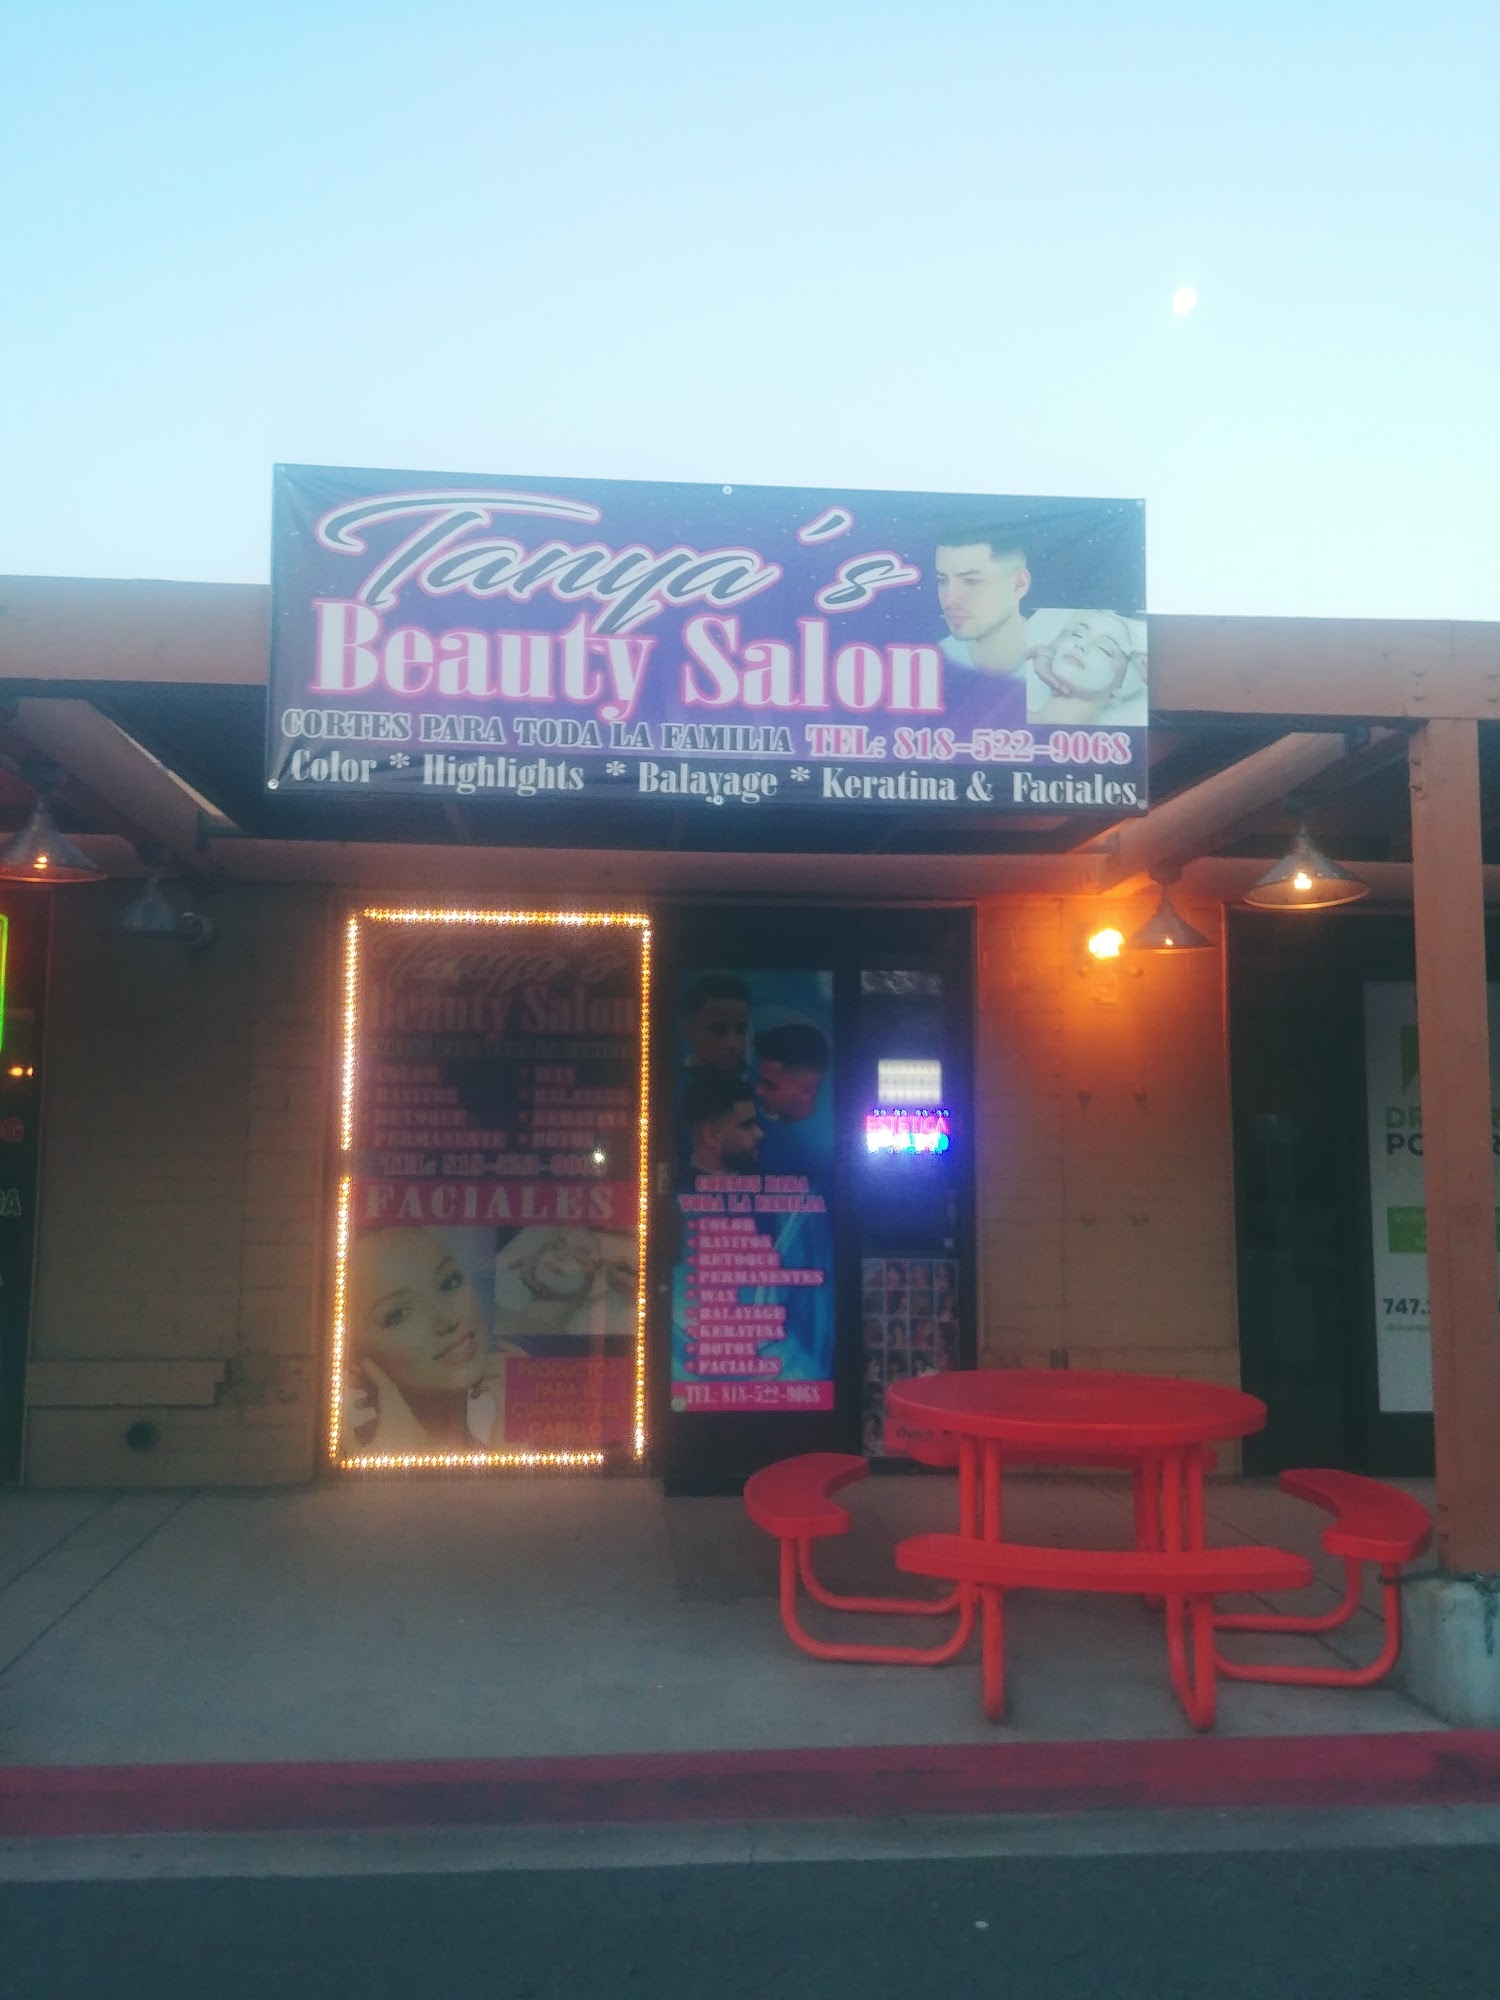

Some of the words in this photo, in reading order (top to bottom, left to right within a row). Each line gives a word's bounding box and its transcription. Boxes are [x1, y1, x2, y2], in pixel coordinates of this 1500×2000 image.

[314, 487, 921, 637] Tanya's
[309, 599, 657, 724] Beauty
[681, 613, 946, 716] Salon
[281, 708, 412, 741] CORTES
[418, 714, 507, 745] PARA
[513, 716, 603, 749] TODA
[609, 720, 653, 750] LA
[660, 722, 795, 755] FAMILIA
[805, 723, 886, 758] TEL:
[893, 727, 1133, 764] 818-522-9068
[290, 749, 377, 783] Color
[422, 753, 584, 796] Highlights
[637, 761, 779, 805] Balayage
[822, 766, 958, 803] Keratina
[965, 770, 995, 802] &
[1012, 770, 1140, 807] Faciales
[366, 1184, 616, 1219] FACIALES
